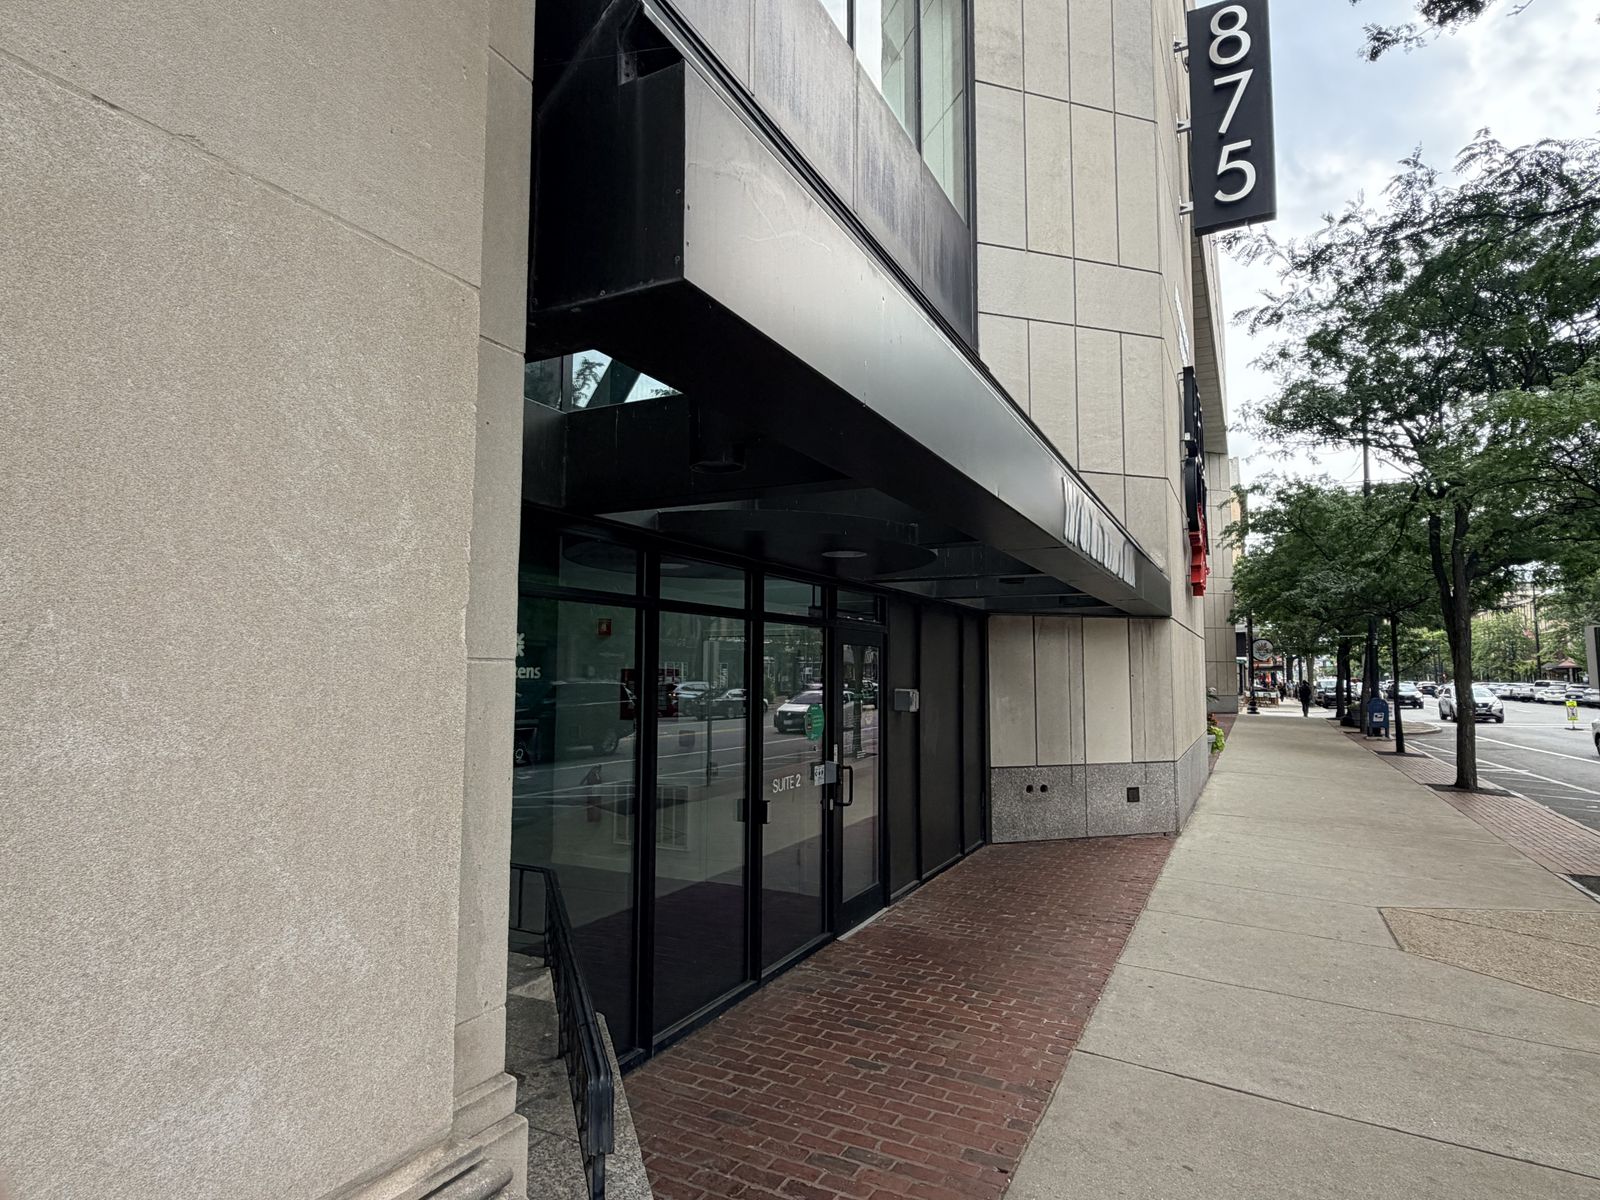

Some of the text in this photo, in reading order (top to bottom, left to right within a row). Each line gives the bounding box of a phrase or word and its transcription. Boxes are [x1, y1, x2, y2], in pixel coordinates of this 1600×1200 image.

[1208, 4, 1257, 203] 875
[516, 666, 541, 679] ens
[772, 775, 795, 793] SUITE
[795, 773, 801, 787] 2
